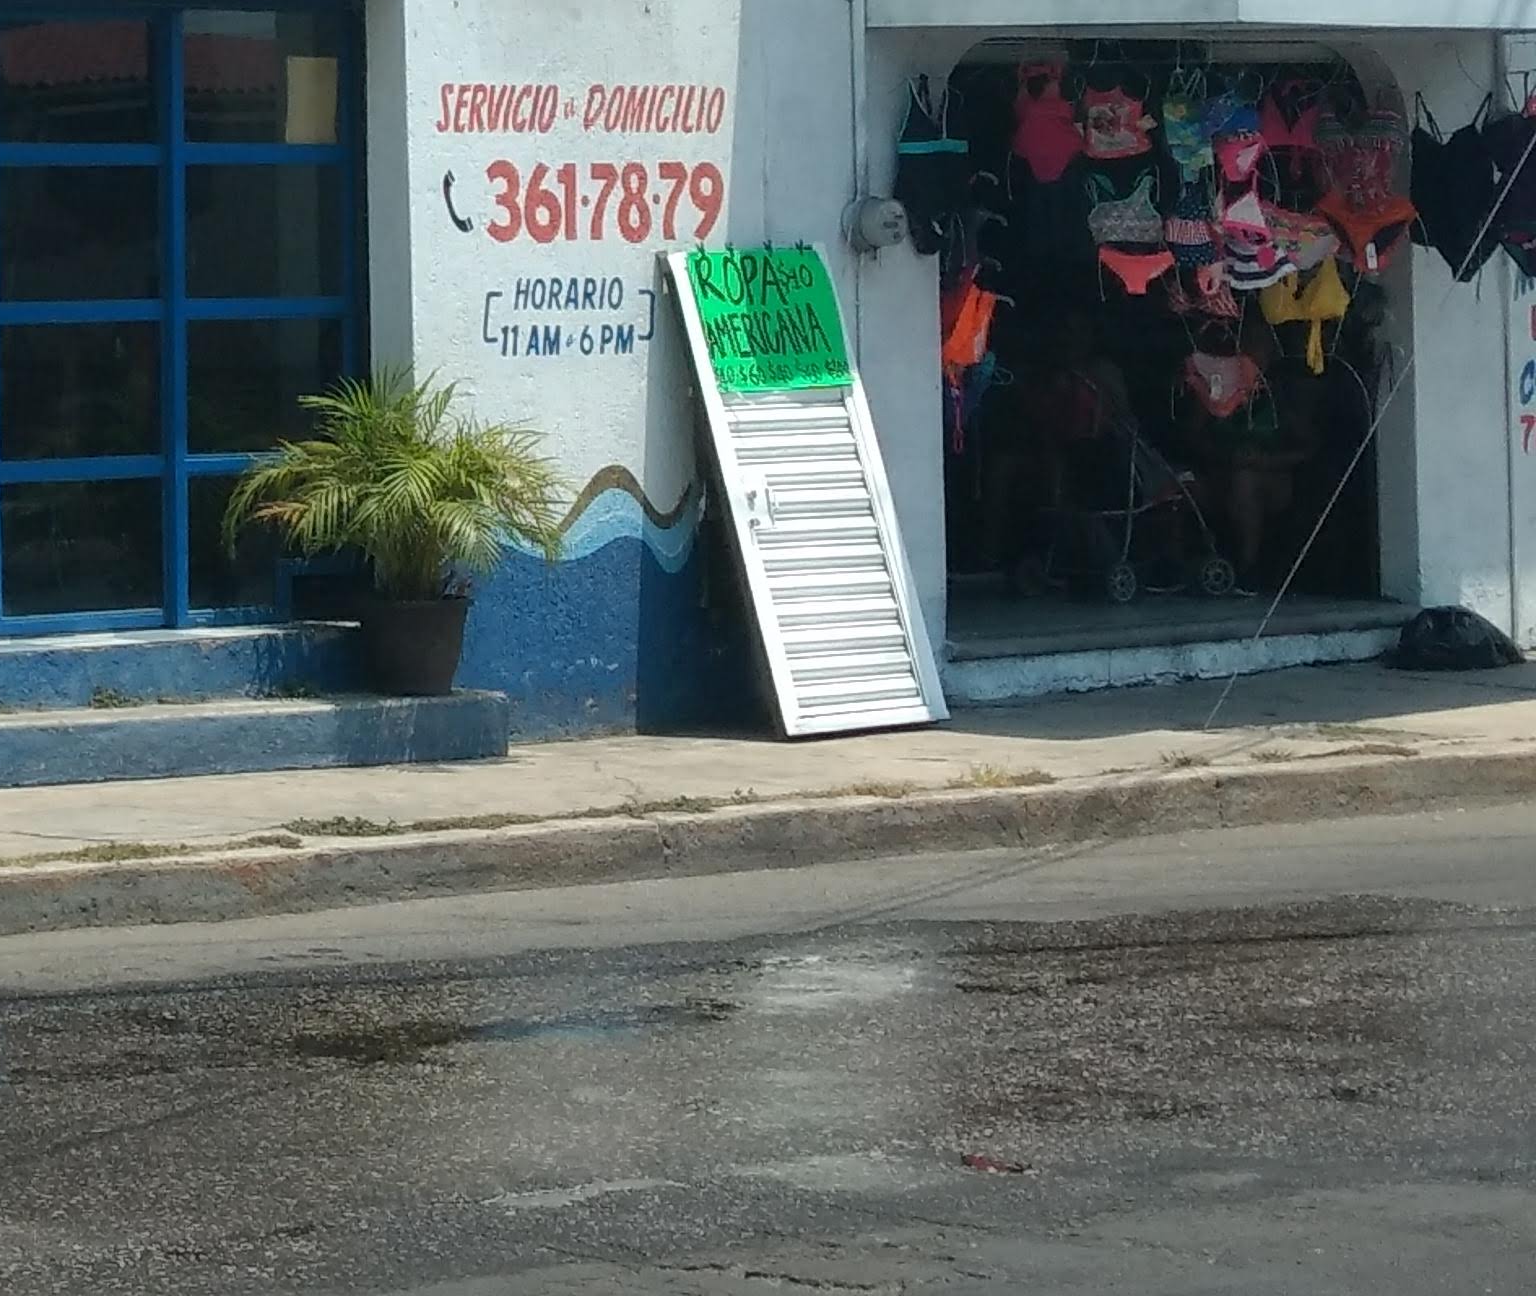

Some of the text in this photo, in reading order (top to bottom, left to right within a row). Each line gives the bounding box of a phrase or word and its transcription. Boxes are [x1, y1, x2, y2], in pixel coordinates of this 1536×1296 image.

[437, 83, 559, 134] SERVICIO
[583, 84, 725, 134] DOMICILIO
[514, 277, 623, 310] HORARIO
[695, 254, 789, 306] ROPA
[501, 325, 519, 356] 11
[526, 325, 561, 355] AM
[580, 325, 594, 356] 6
[600, 324, 634, 354] PM
[705, 303, 832, 358] AMERICANA
